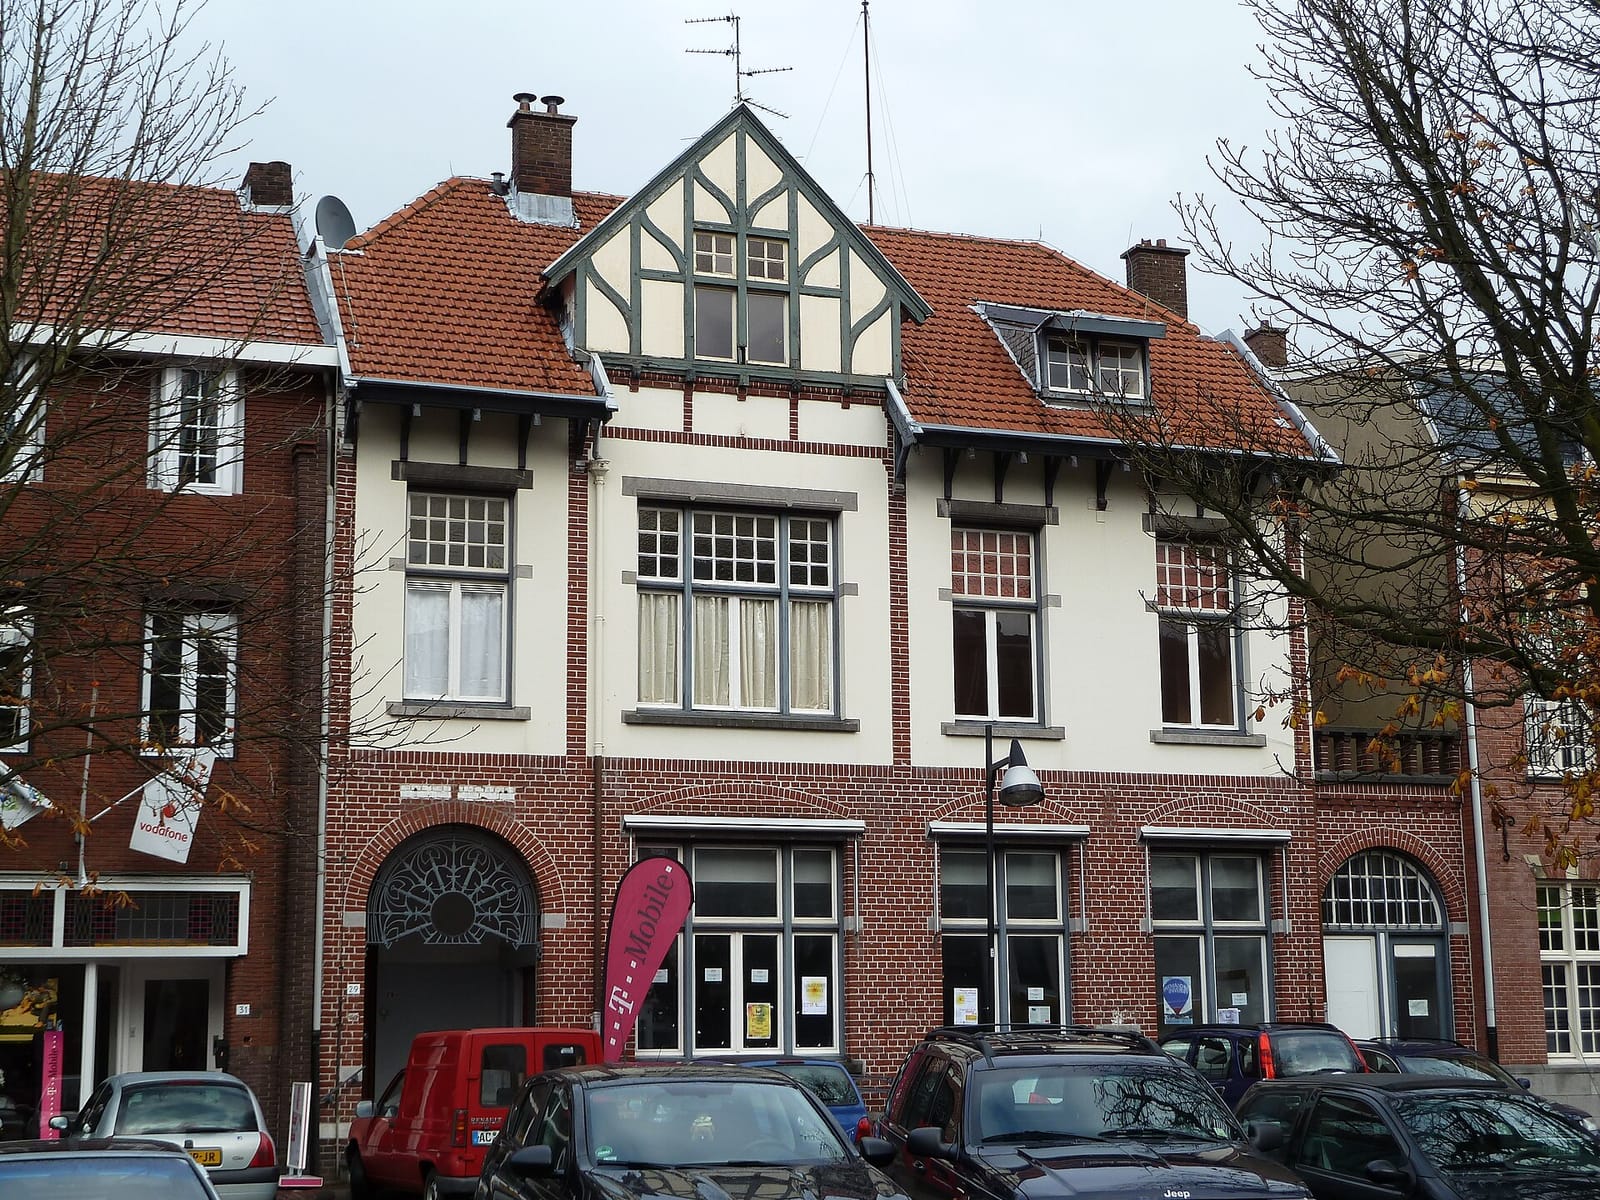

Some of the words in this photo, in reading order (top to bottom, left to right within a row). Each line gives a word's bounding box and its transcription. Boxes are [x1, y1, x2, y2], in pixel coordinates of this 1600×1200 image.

[140, 822, 188, 842] vodafone
[624, 874, 675, 965] Mobile
[348, 985, 359, 994] 29
[239, 1005, 248, 1014] 31
[1163, 1190, 1190, 1199] Jeep
